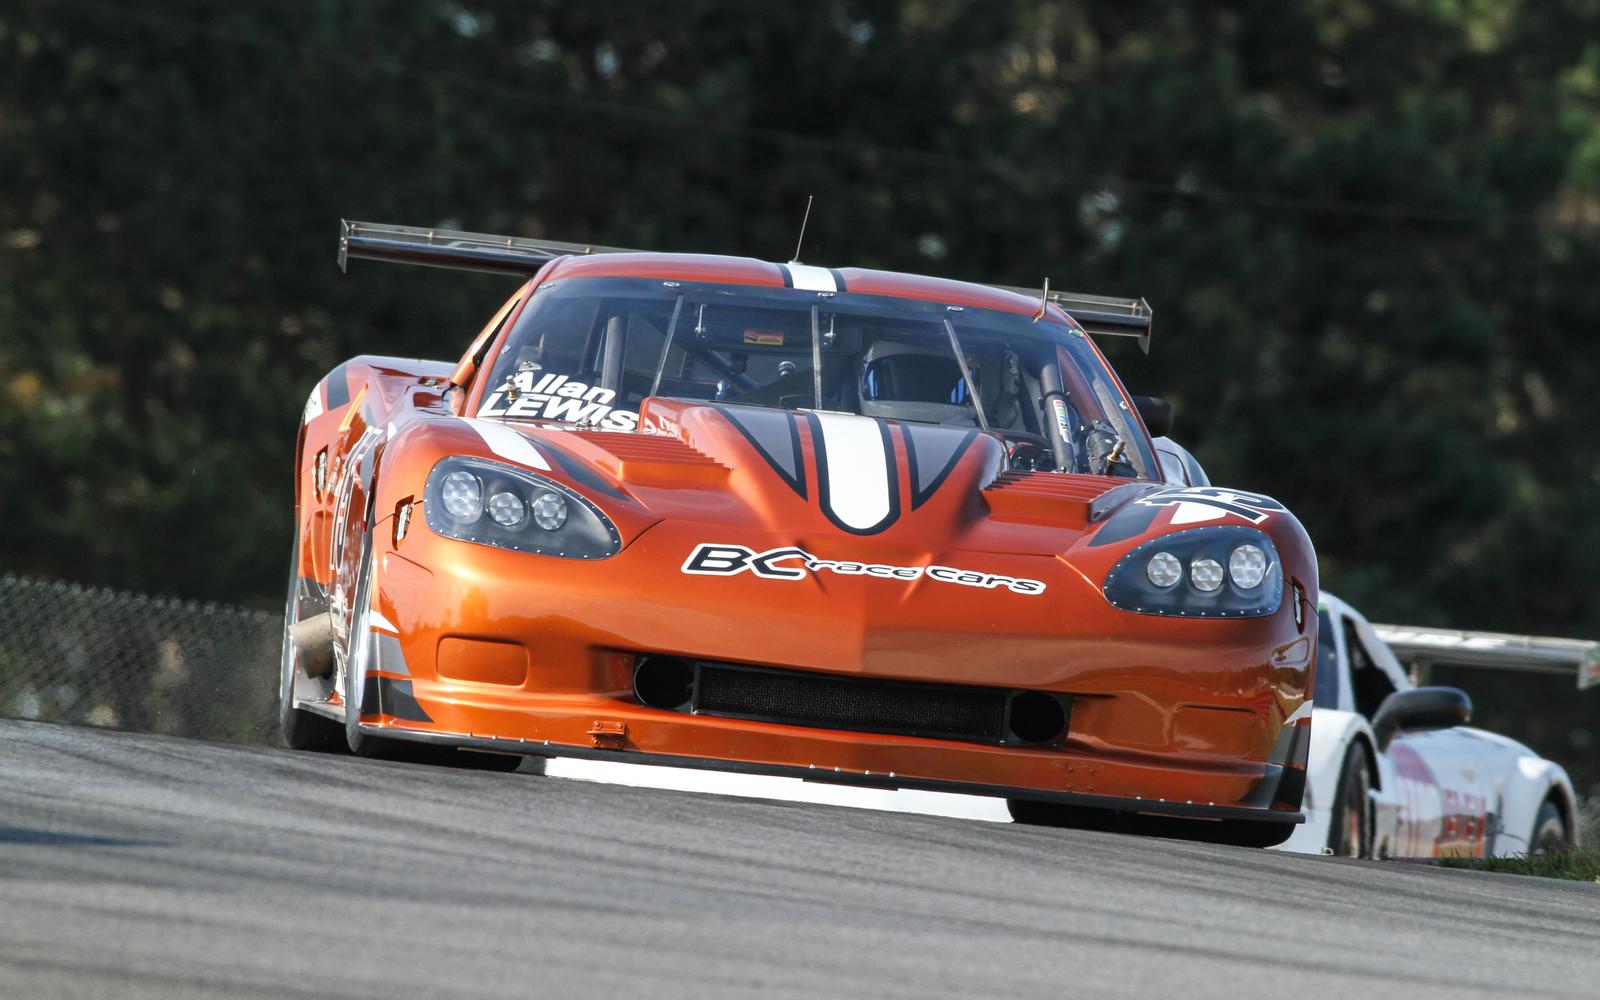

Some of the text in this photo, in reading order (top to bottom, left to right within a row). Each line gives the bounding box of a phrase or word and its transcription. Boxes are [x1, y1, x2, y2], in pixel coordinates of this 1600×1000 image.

[495, 371, 616, 404] Allan
[477, 392, 640, 431] LEWIS
[682, 544, 813, 580] BC
[807, 561, 922, 579] race
